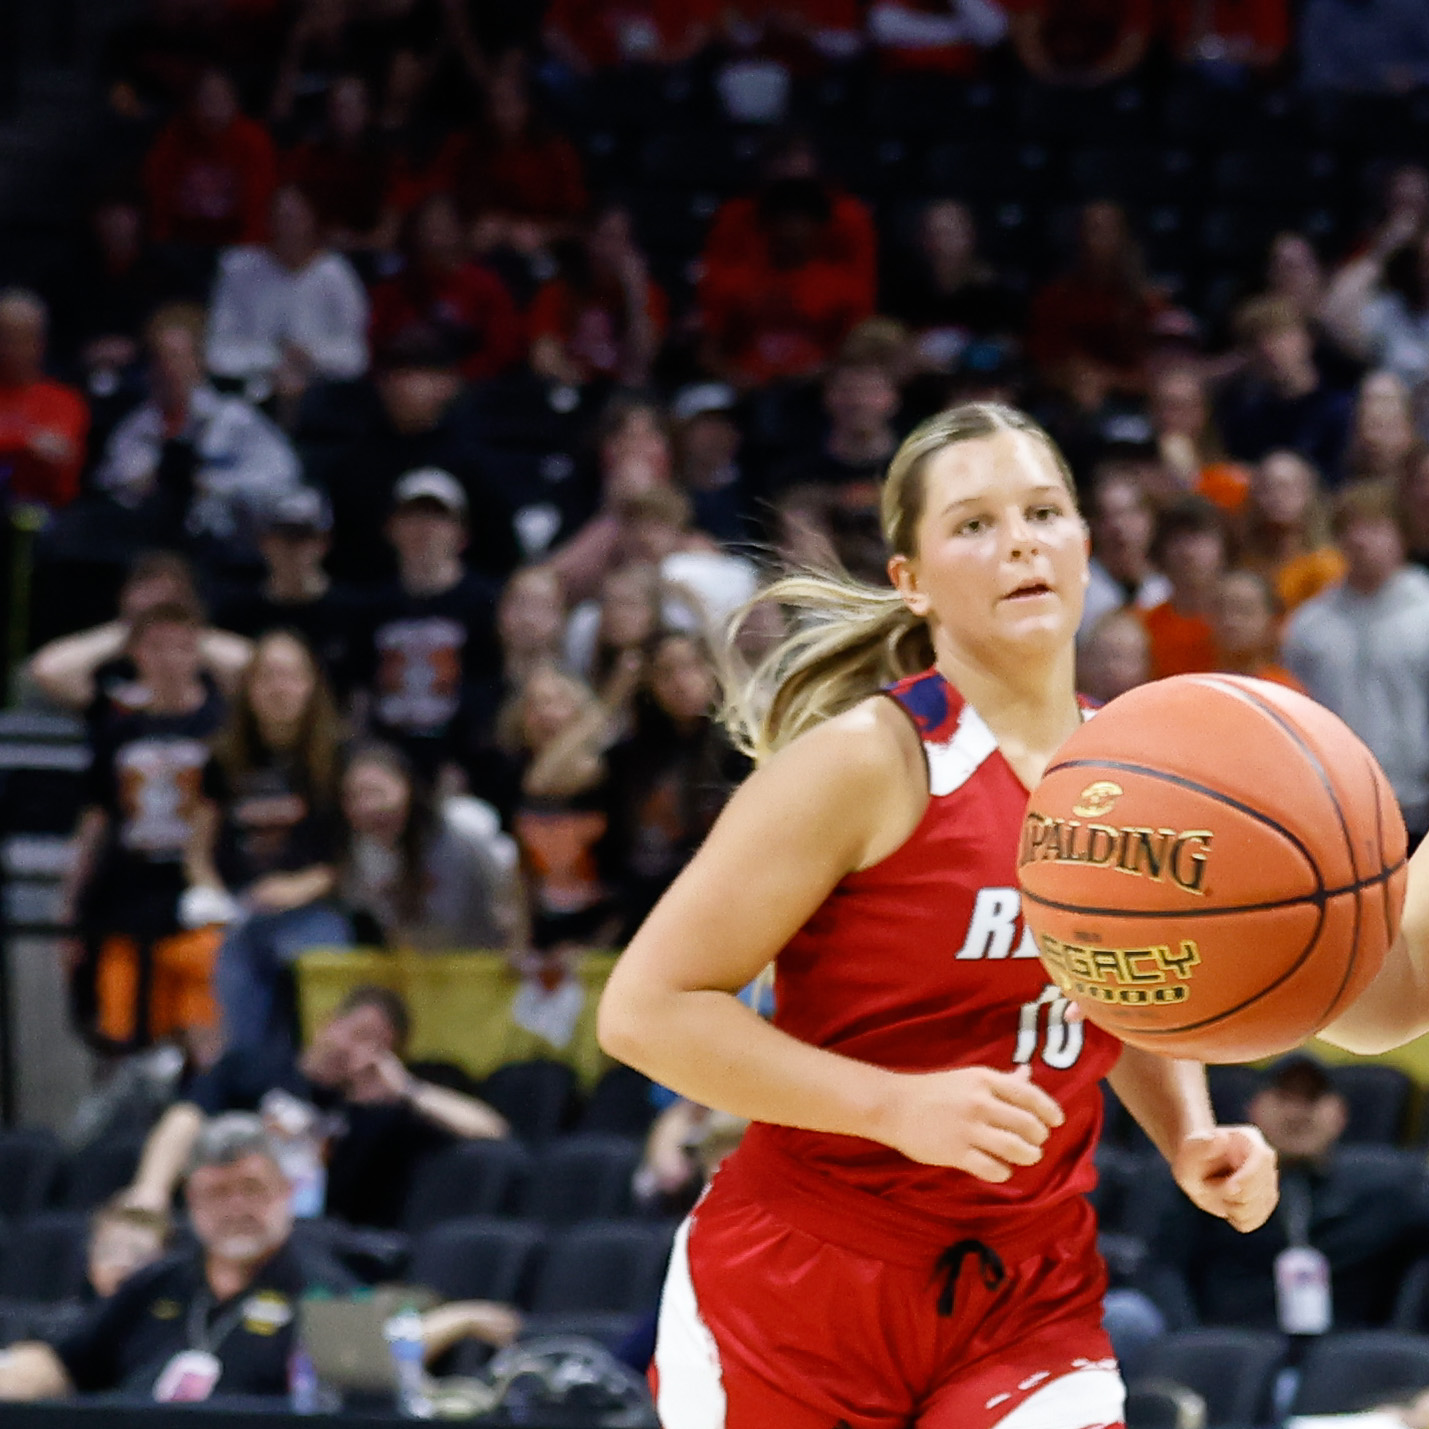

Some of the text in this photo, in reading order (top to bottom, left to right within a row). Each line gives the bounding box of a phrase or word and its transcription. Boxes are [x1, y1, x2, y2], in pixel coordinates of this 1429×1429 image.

[1021, 813, 1215, 896] PALDING
[1041, 933, 1201, 981] EGACY
[1012, 983, 1085, 1070] 10
